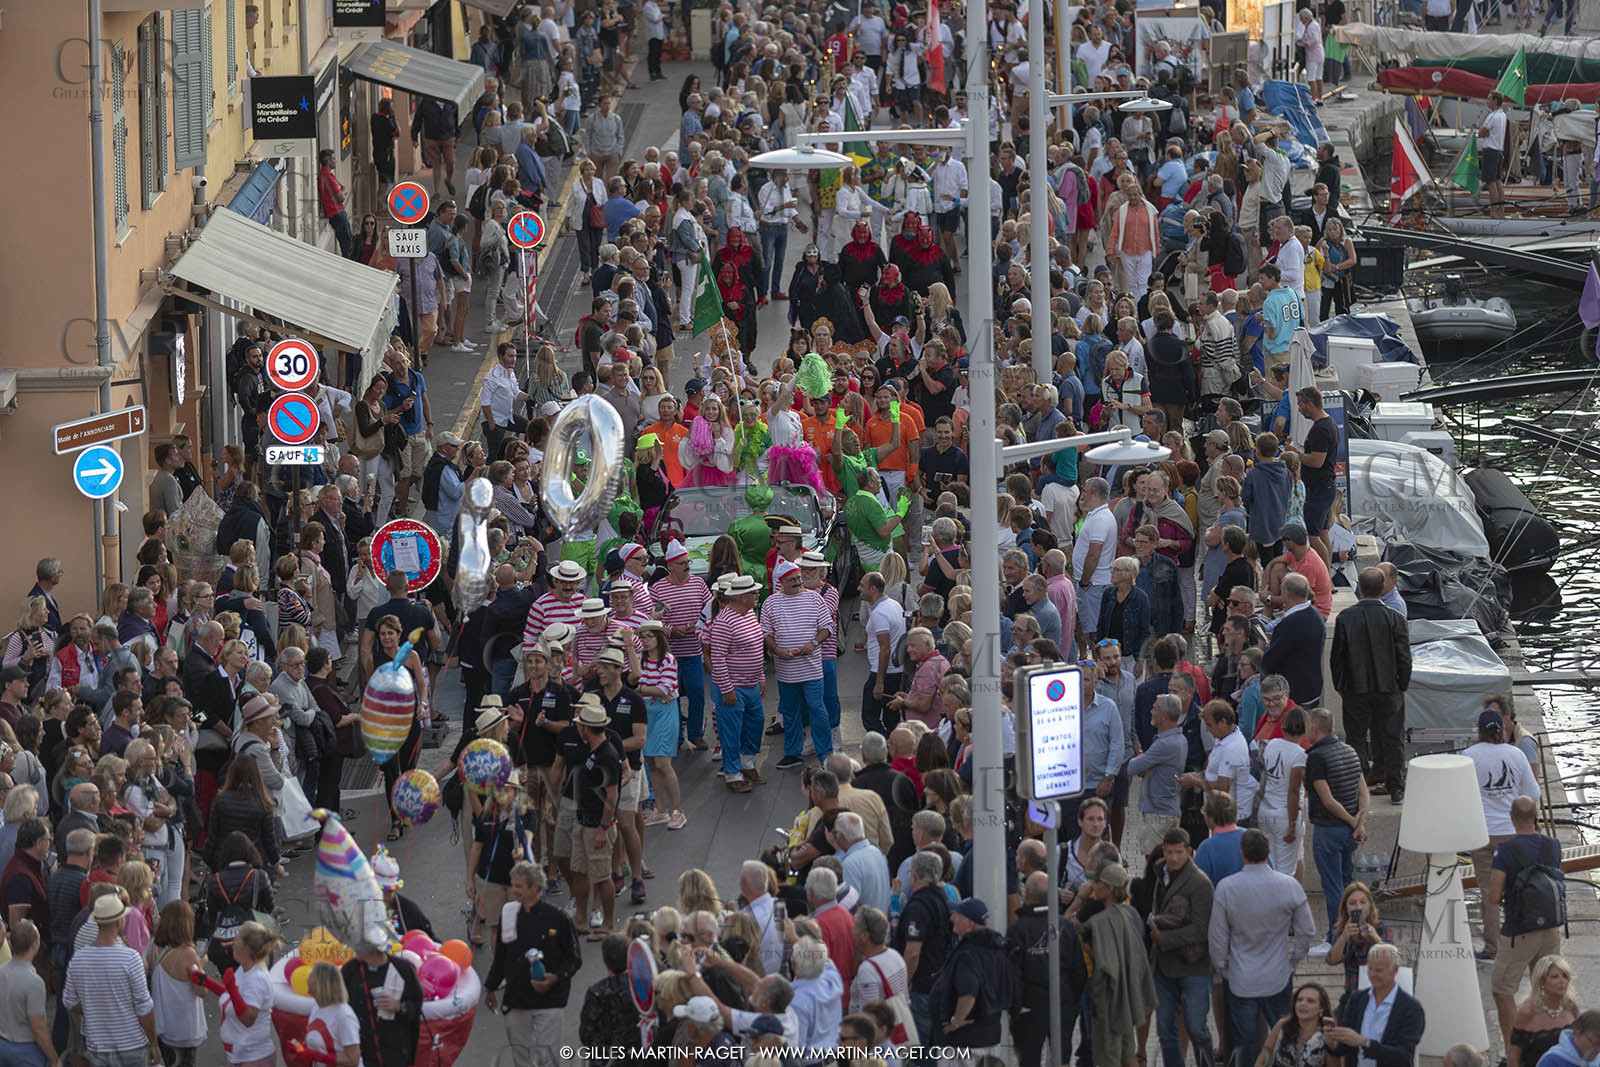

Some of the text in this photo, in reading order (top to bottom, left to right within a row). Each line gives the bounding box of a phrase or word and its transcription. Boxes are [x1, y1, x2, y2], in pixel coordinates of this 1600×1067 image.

[395, 233, 419, 241] SAUF
[395, 245, 421, 254] TAXIS
[278, 354, 308, 376] 30
[269, 451, 301, 460] SAUF
